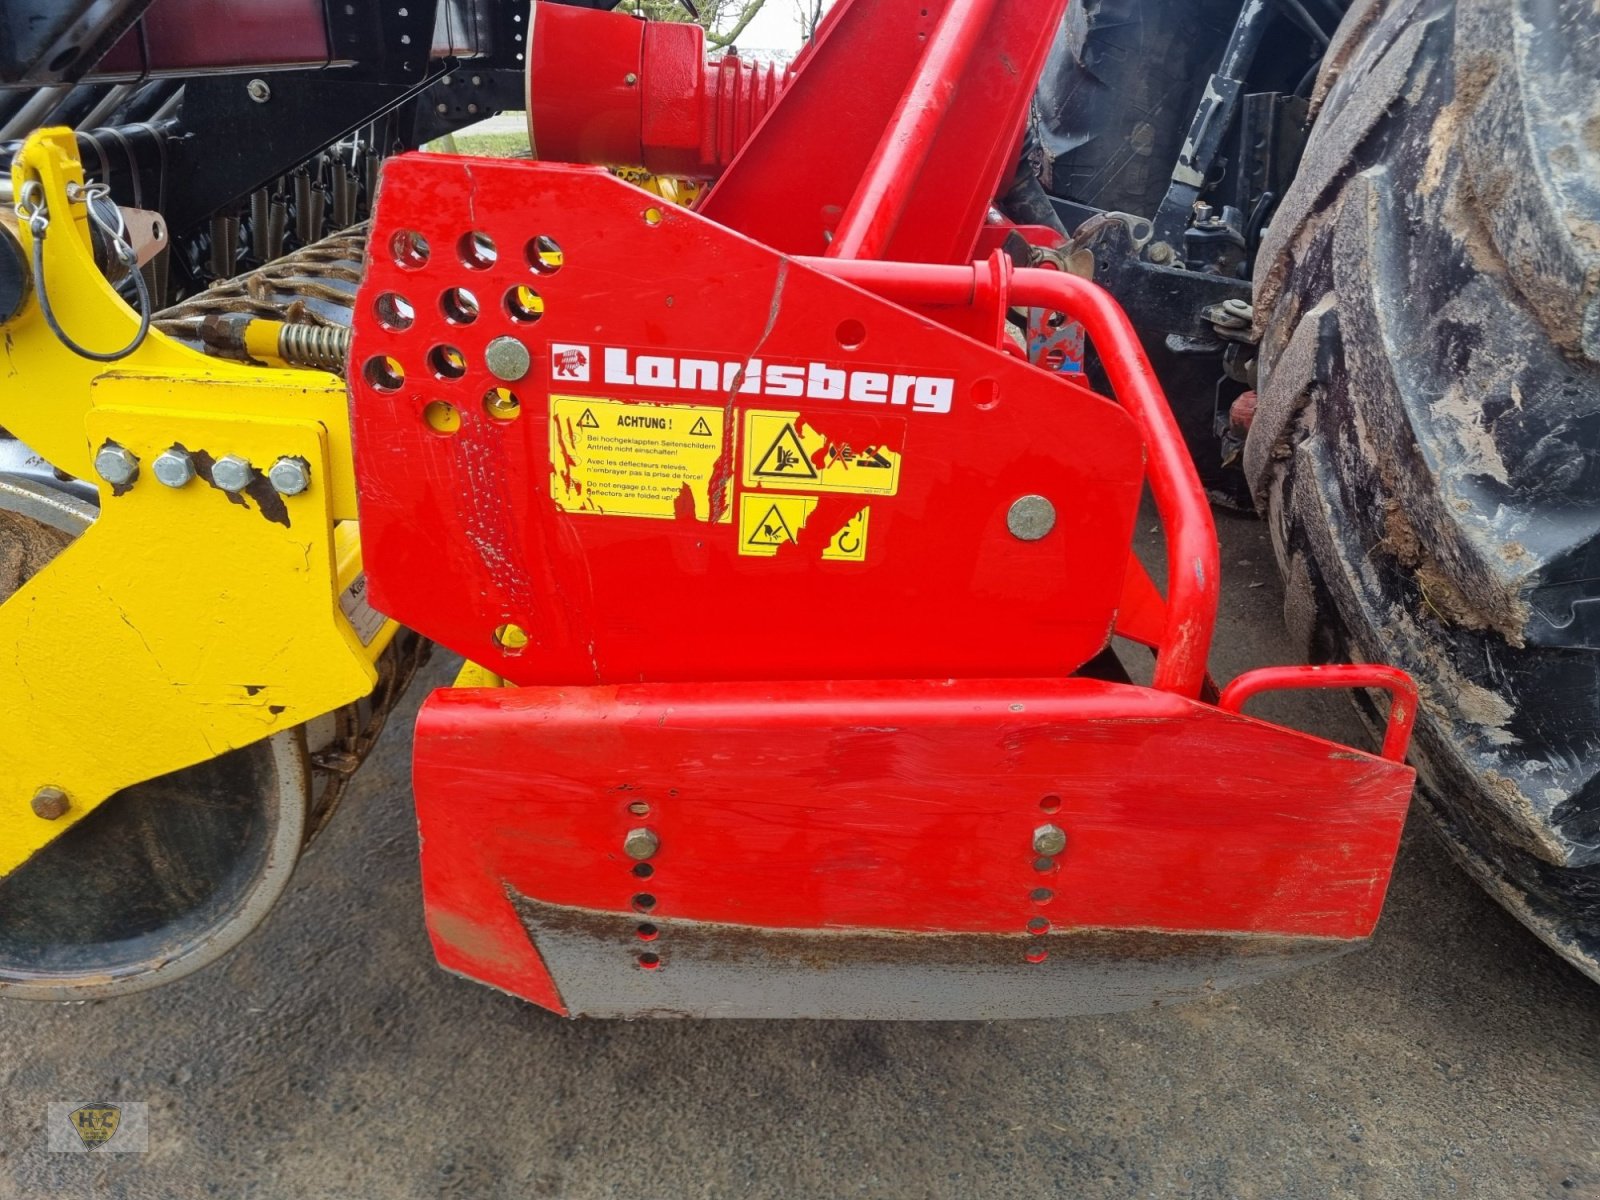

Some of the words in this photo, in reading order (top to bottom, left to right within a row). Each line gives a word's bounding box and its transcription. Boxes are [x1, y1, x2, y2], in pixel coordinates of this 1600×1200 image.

[604, 347, 954, 413] Landsberg
[617, 415, 666, 429] ACHTUNG
[587, 434, 599, 442] Bei
[600, 436, 659, 446] hochgeklappten
[660, 440, 716, 450] Seitenschildern
[587, 443, 613, 452] Antrieb
[614, 445, 633, 453] nicht
[634, 448, 678, 456] einschalten!
[587, 457, 604, 465] Avec
[644, 469, 651, 477] la
[652, 470, 670, 478] prise
[612, 482, 640, 491] engage
[637, 492, 660, 500] folded
